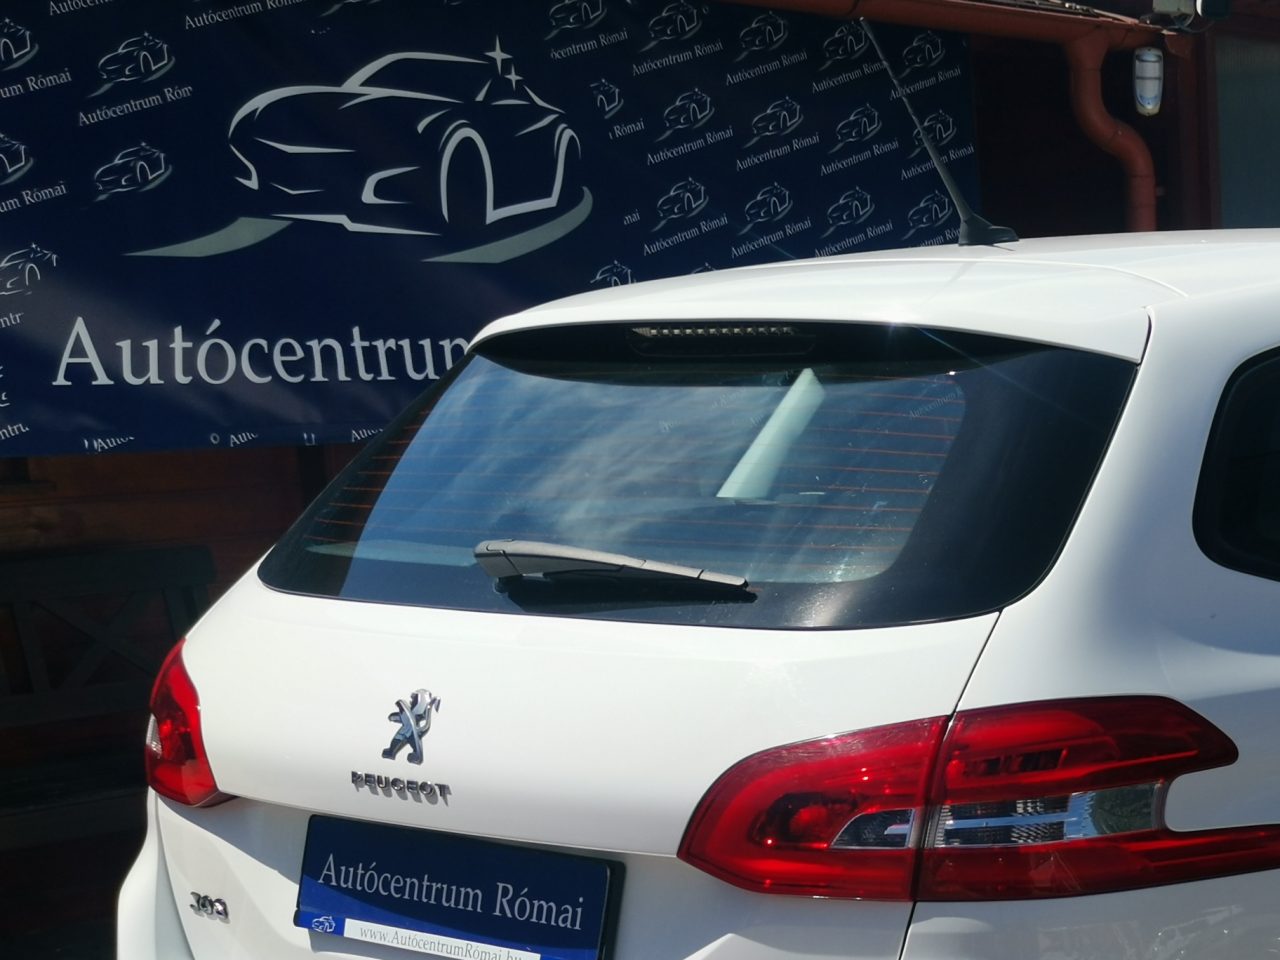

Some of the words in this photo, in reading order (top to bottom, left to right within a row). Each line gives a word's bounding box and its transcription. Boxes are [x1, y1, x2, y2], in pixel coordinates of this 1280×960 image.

[185, 2, 263, 30] Autócentrum
[26, 67, 72, 91] Római
[79, 94, 163, 127] Autócentrum
[351, 771, 450, 798] PEUGEOT
[317, 853, 484, 913] Autócentrum
[493, 882, 584, 931] Római
